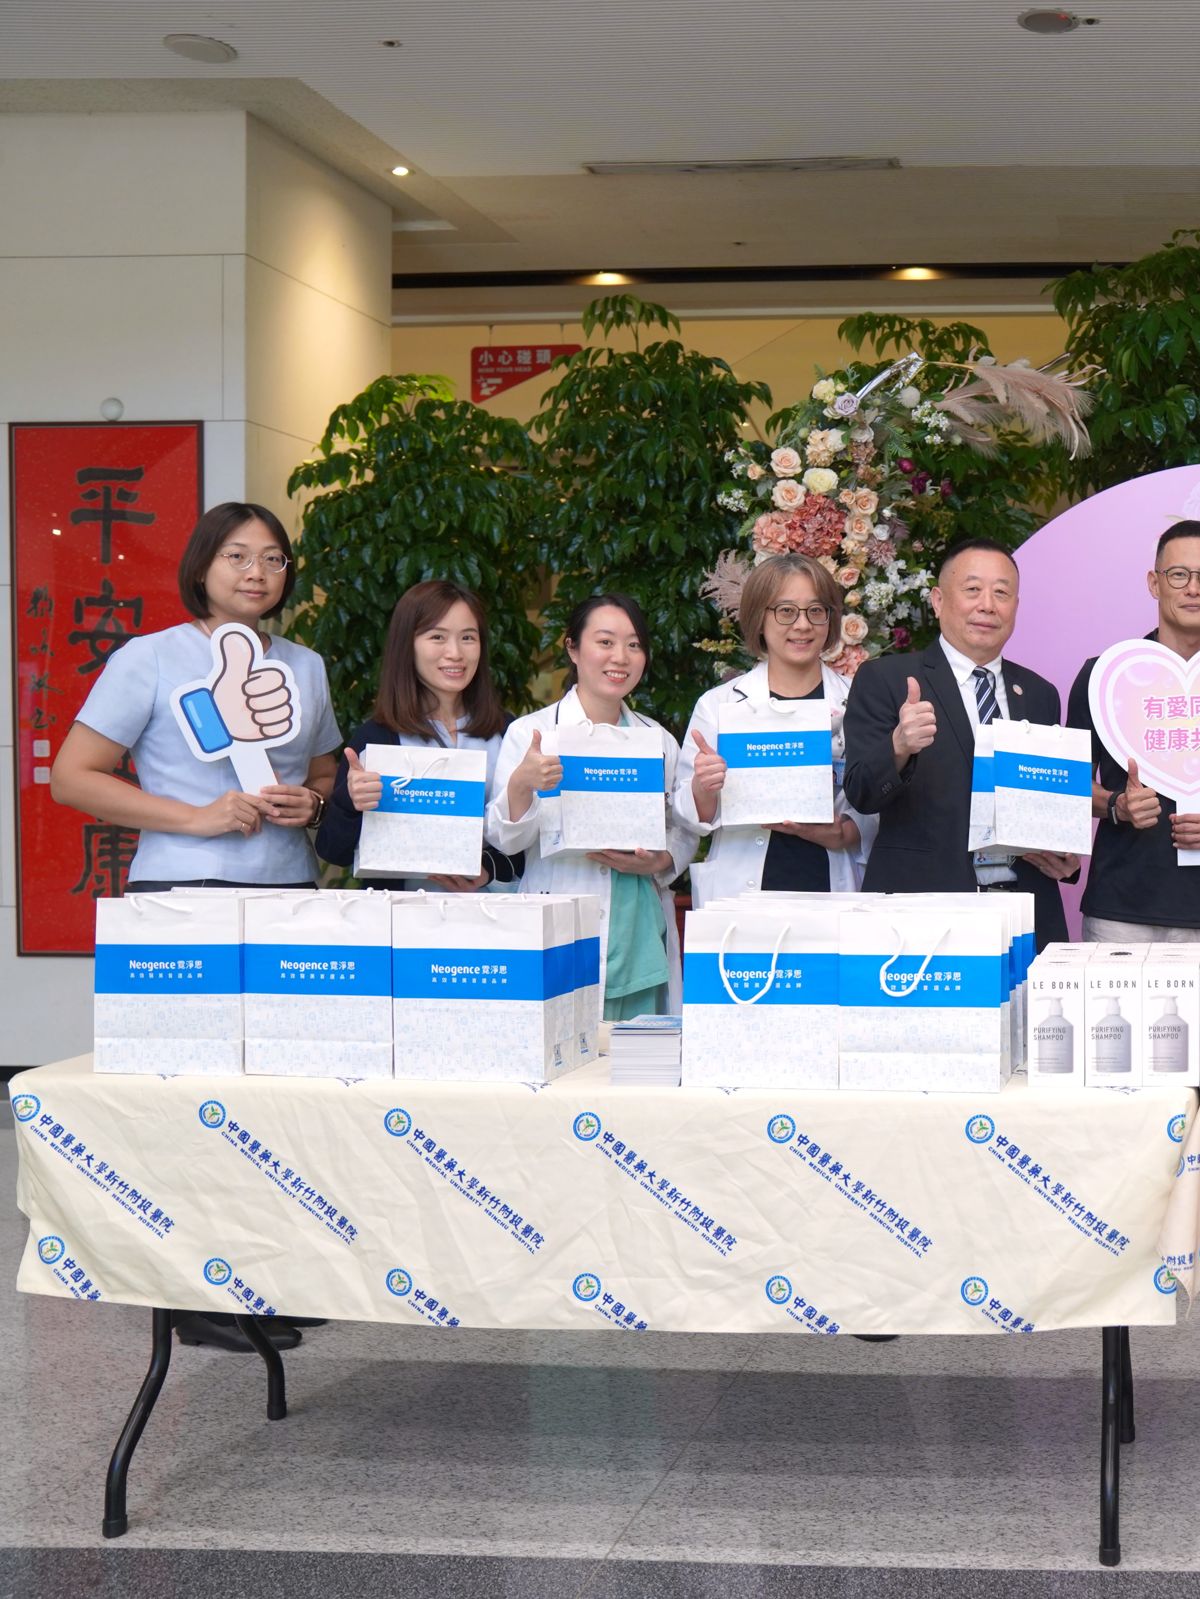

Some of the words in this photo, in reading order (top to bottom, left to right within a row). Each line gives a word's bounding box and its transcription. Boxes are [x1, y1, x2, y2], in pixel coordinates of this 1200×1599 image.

[479, 349, 551, 365] 小心碰頭
[68, 466, 156, 898] 平安康
[746, 743, 784, 752] Neogence
[584, 767, 619, 776] Neogence
[1018, 764, 1052, 775] Neogence
[393, 788, 434, 798] Neogence
[129, 960, 176, 972] Neogence
[280, 960, 328, 972] Neogence
[431, 964, 480, 976] Neogence
[1033, 981, 1044, 990] LE
[1090, 980, 1101, 988] LE
[1109, 980, 1136, 988] BORN
[1147, 980, 1159, 988] LE
[40, 1114, 175, 1233] 中國醫藥大學新竹附設醫院
[228, 1120, 358, 1241] 中國醫藥大學新竹附設醫院
[30, 1125, 48, 1142] CHINA
[50, 1142, 74, 1163] MEDICAL
[77, 1165, 110, 1193] UNIVERSITY
[112, 1193, 136, 1215] HSINCHU
[138, 1216, 164, 1240] HOSPITAL
[221, 1131, 237, 1147] CHINA
[240, 1148, 262, 1170] MEDICAL
[265, 1171, 296, 1198] UNIVERSITY
[299, 1200, 323, 1220] HSINCHU
[326, 1222, 351, 1245] HOSPITAL
[413, 1128, 544, 1249] 中國醫藥大學新竹附設醫院
[406, 1139, 422, 1156] CHINA
[425, 1157, 447, 1178] MEDICAL
[450, 1179, 482, 1207] UNIVERSITY
[484, 1208, 509, 1230] HSINCHU
[511, 1231, 535, 1254] HOSPITAL
[603, 1131, 737, 1251] 中國醫藥大學新竹附設醫院
[797, 1134, 932, 1252] 中國醫藥大學新竹附設醫院
[996, 1135, 1130, 1251] 中國醫藥大學新竹附設醫院
[596, 1143, 612, 1158] CHINA
[614, 1159, 637, 1181] MEDICAL
[640, 1181, 672, 1209] UNIVERSITY
[674, 1211, 699, 1231] HSINCHU
[701, 1233, 727, 1256] HOSPITAL
[789, 1146, 806, 1161] CHINA
[809, 1162, 832, 1182] MEDICAL
[835, 1183, 867, 1211] UNIVERSITY
[869, 1212, 894, 1233] HSINCHU
[896, 1235, 922, 1258] HOSPITAL
[988, 1146, 1005, 1162] CHINA
[1007, 1163, 1031, 1184] MEDICAL
[1034, 1186, 1066, 1214] UNIVERSITY
[1067, 1216, 1092, 1237] HSINCHU
[1094, 1238, 1119, 1256] HOSPITAL
[53, 1268, 68, 1285] CHINA
[227, 1287, 243, 1303] CHINA
[407, 1299, 424, 1315] CHINA
[594, 1304, 611, 1319] CHINA
[786, 1307, 803, 1323] CHINA
[981, 1309, 998, 1324] CHINA
